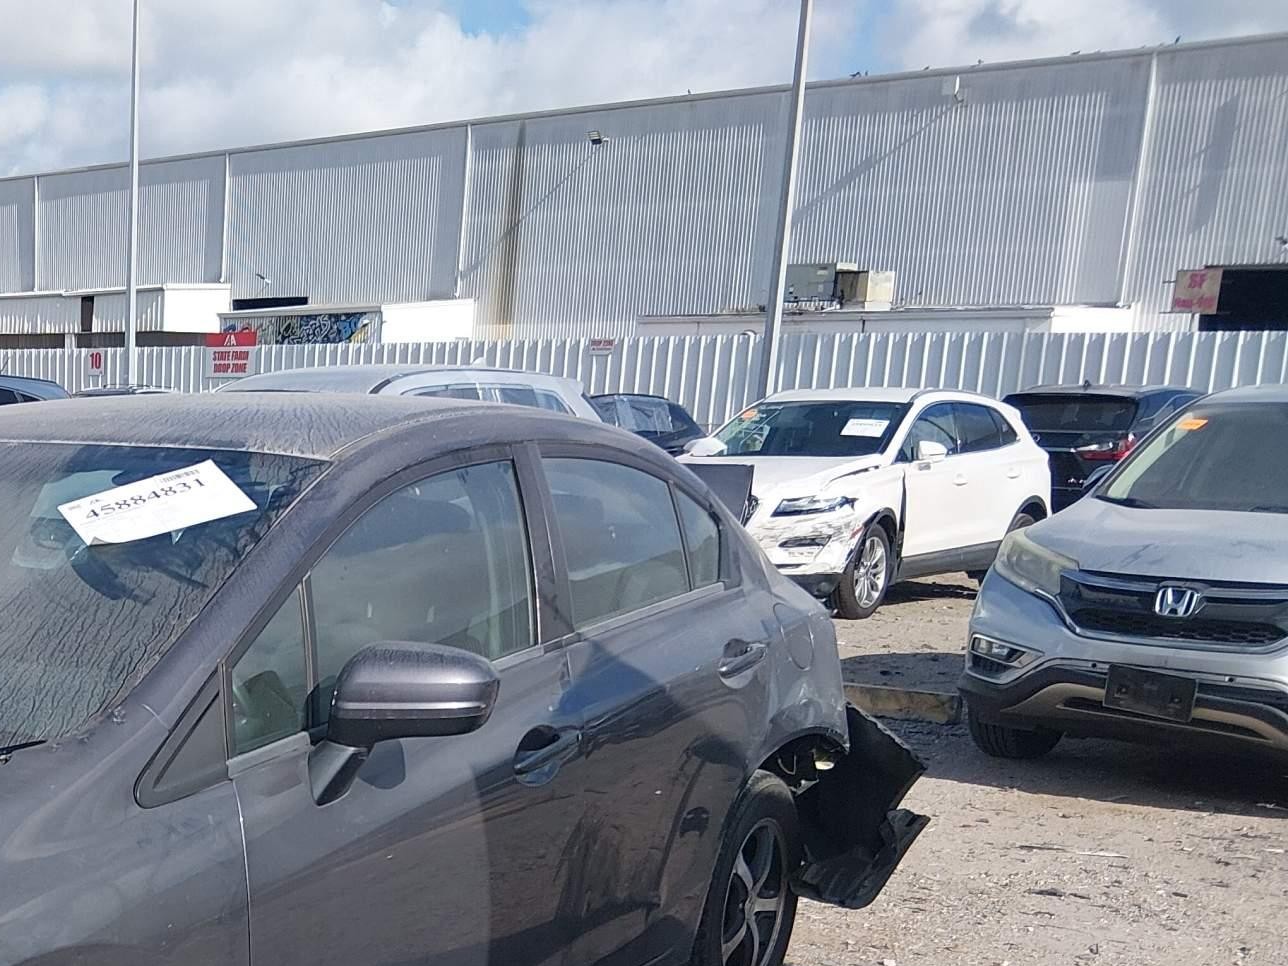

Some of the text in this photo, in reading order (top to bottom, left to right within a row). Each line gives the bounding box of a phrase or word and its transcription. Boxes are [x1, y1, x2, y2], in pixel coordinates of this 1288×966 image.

[89, 352, 102, 369] 10
[213, 350, 249, 361] STATE FARM
[214, 363, 247, 373] DROP ZONE
[85, 478, 206, 520] 45884831
